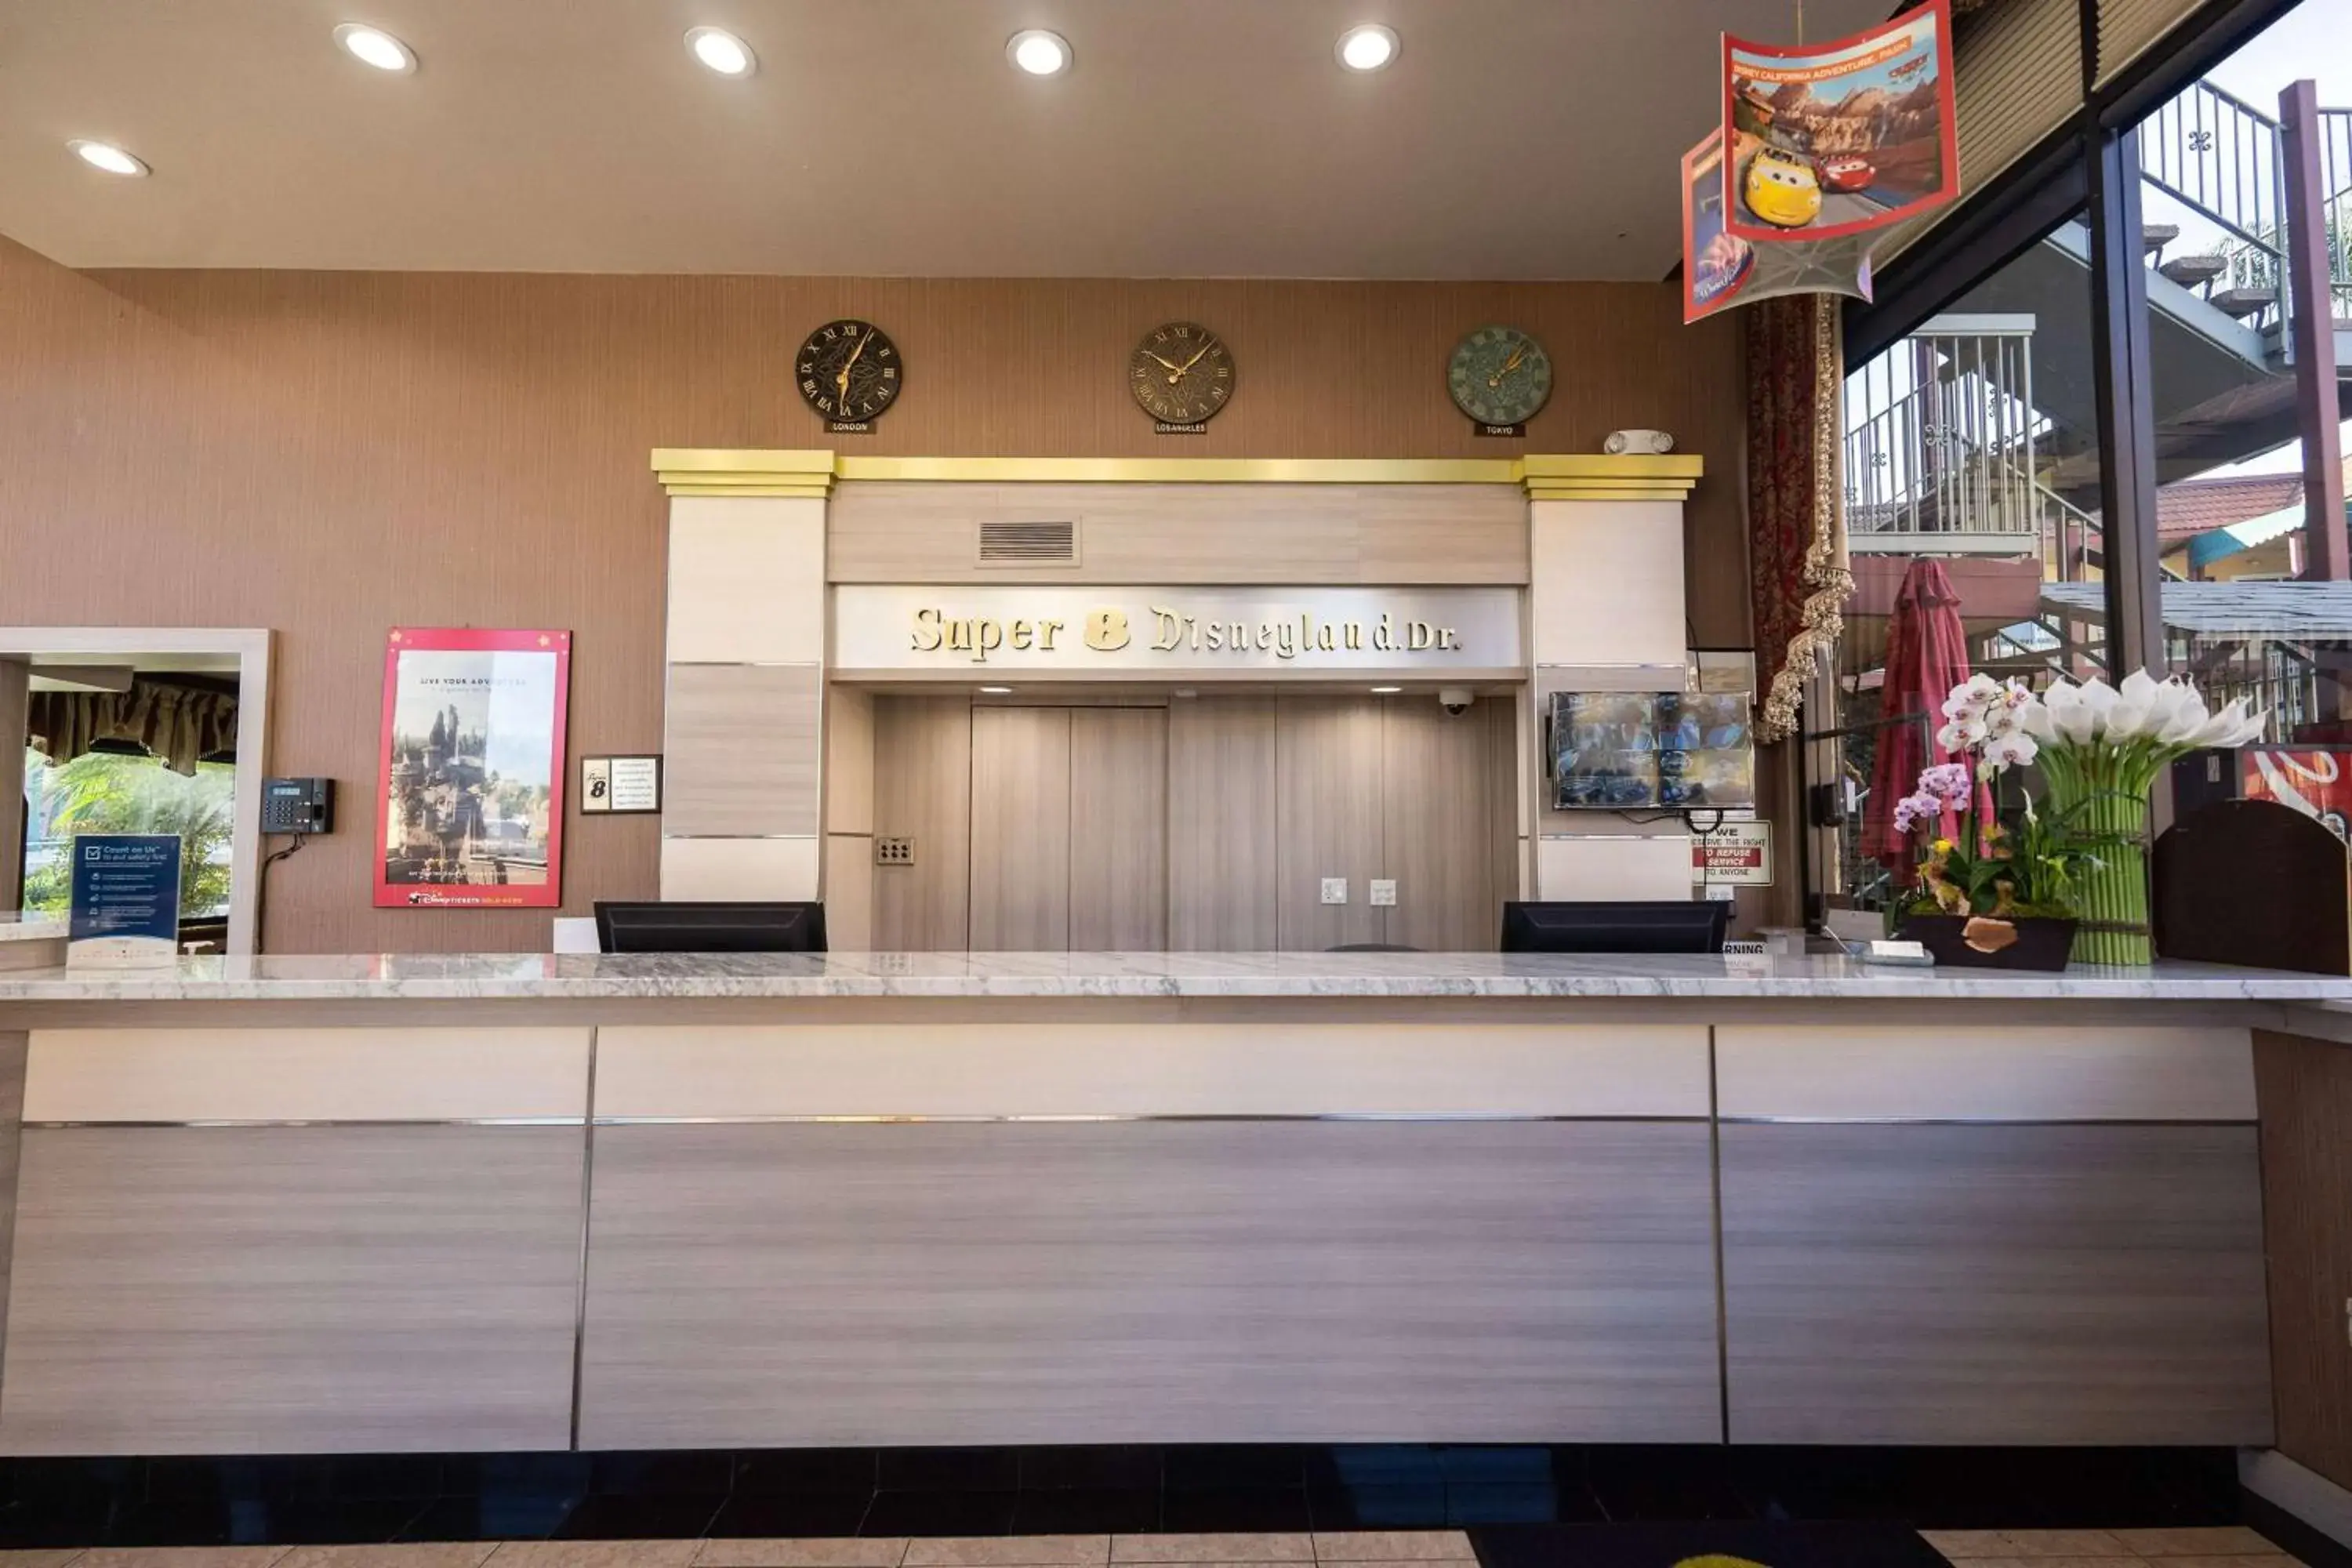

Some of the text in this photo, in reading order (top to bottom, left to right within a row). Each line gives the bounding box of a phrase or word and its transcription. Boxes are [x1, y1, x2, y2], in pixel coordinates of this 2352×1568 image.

[843, 325, 857, 336] XII
[884, 368, 895, 378] III
[912, 608, 1064, 662] Super
[1083, 607, 1131, 651] 8
[590, 781, 606, 798] 8
[1716, 828, 1738, 837] WE
[1725, 945, 1764, 954] RNING
